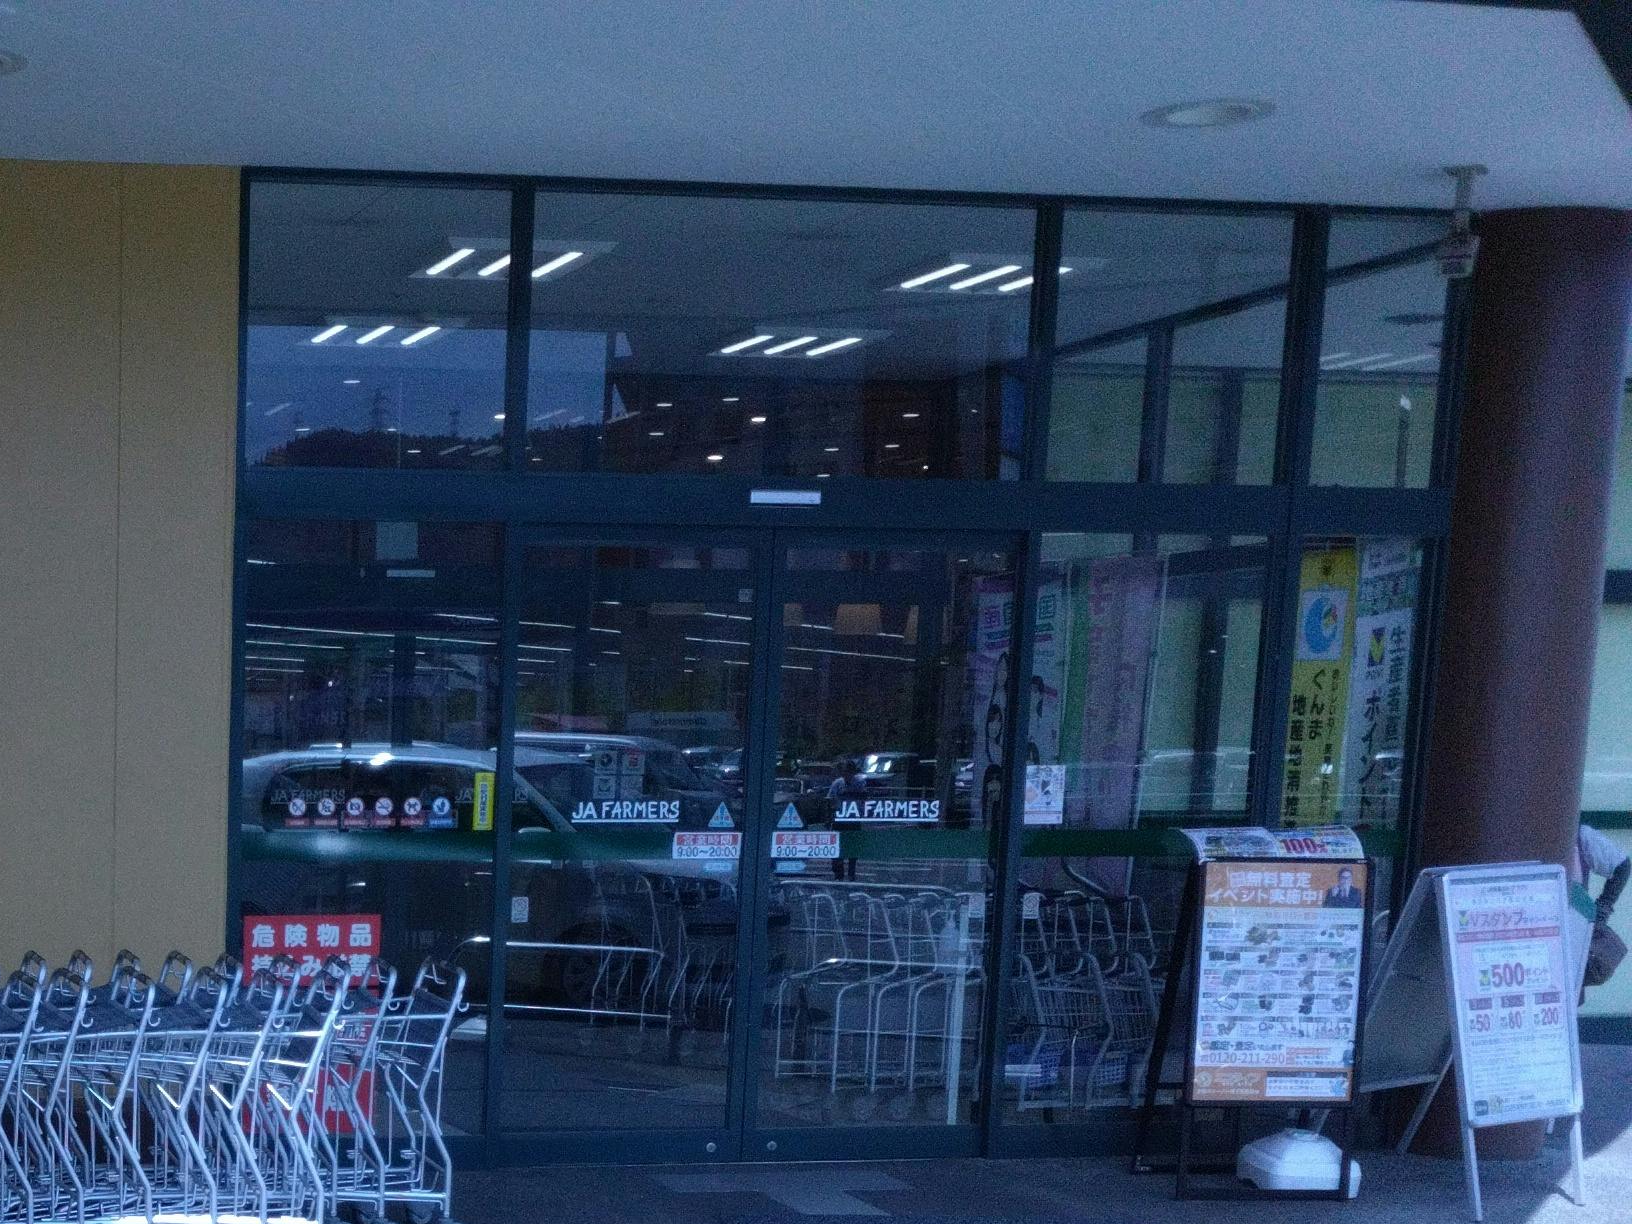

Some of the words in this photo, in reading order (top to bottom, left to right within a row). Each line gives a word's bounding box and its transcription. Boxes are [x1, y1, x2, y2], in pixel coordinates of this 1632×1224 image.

[572, 801, 598, 818] JA
[602, 800, 679, 818] FARMERS
[835, 801, 859, 818] JA
[863, 800, 939, 818] FARMERS
[683, 834, 733, 845] 営業時間
[782, 834, 830, 845] 営業時間
[252, 923, 372, 947] 危険物品
[1491, 962, 1525, 988] 500
